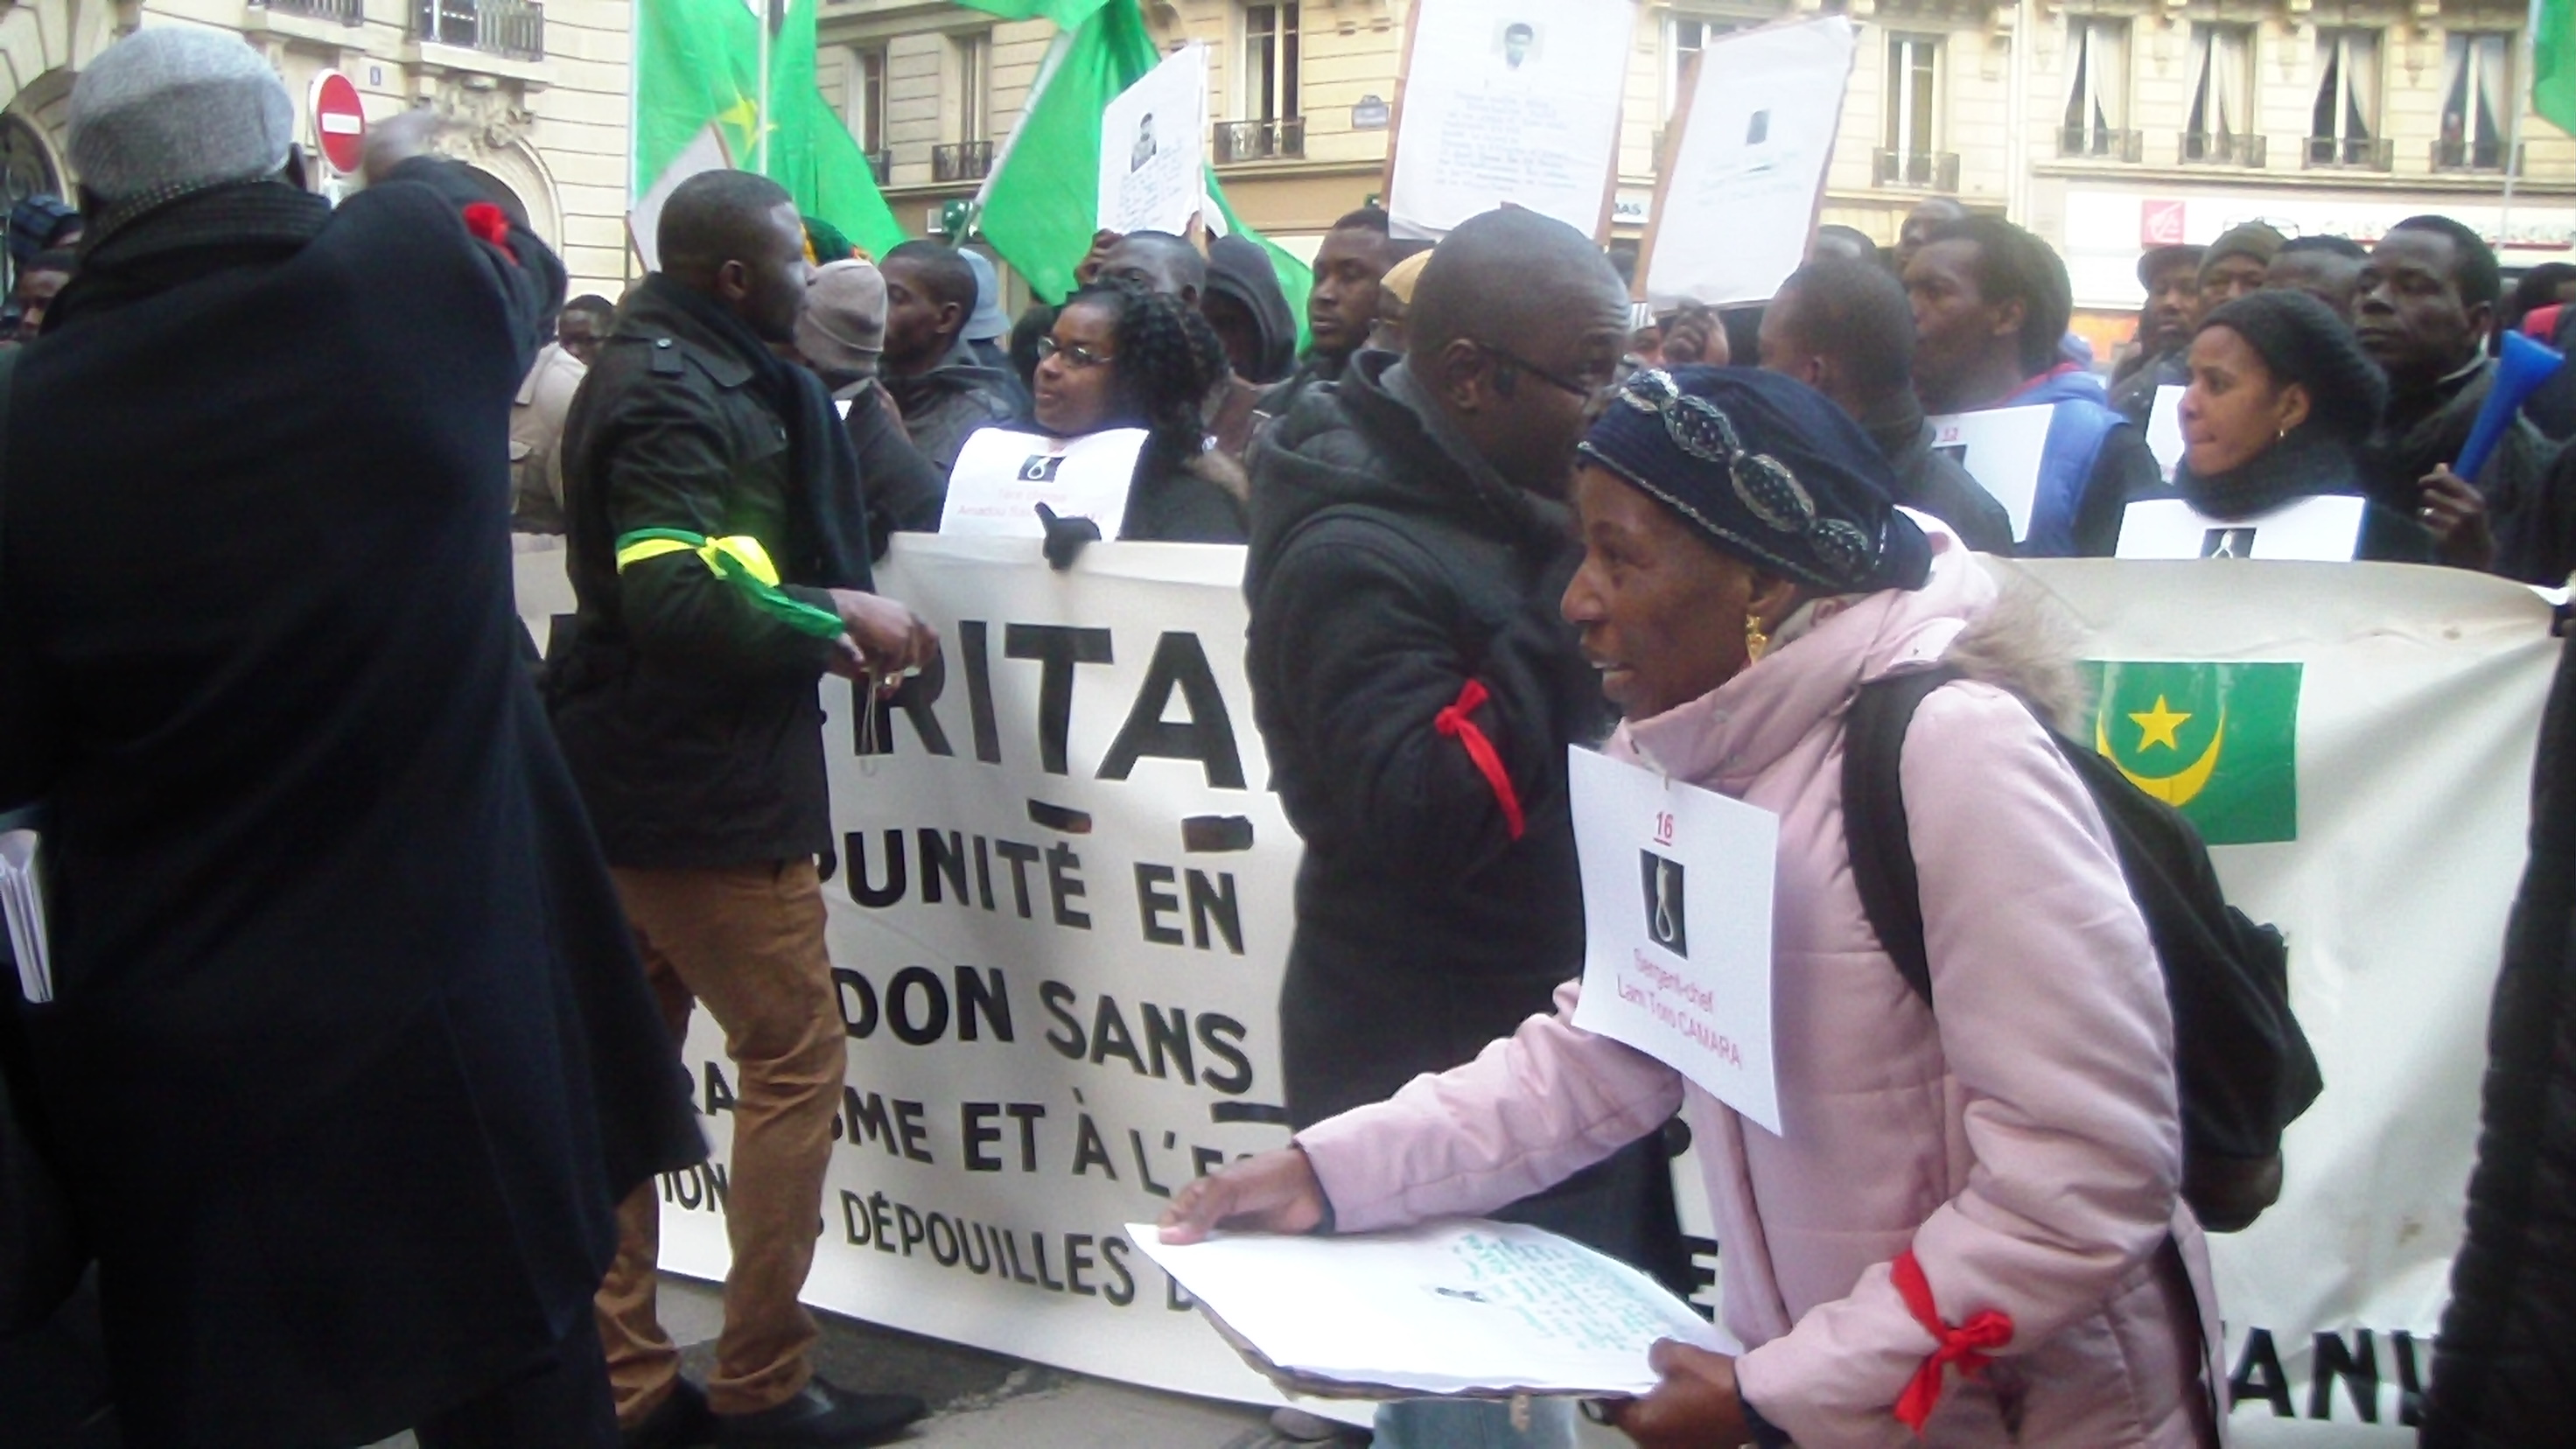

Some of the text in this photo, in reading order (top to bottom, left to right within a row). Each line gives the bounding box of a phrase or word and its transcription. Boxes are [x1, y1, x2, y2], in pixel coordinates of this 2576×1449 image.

[1655, 810, 1674, 841] 16
[1133, 861, 1246, 956] EN
[1040, 978, 1253, 1096] SANS
[1677, 1011, 1743, 1071] CAMARA
[961, 1101, 1046, 1172] ET
[1071, 1088, 1119, 1181] À
[840, 1188, 1135, 1307] DÉPOUILLES
